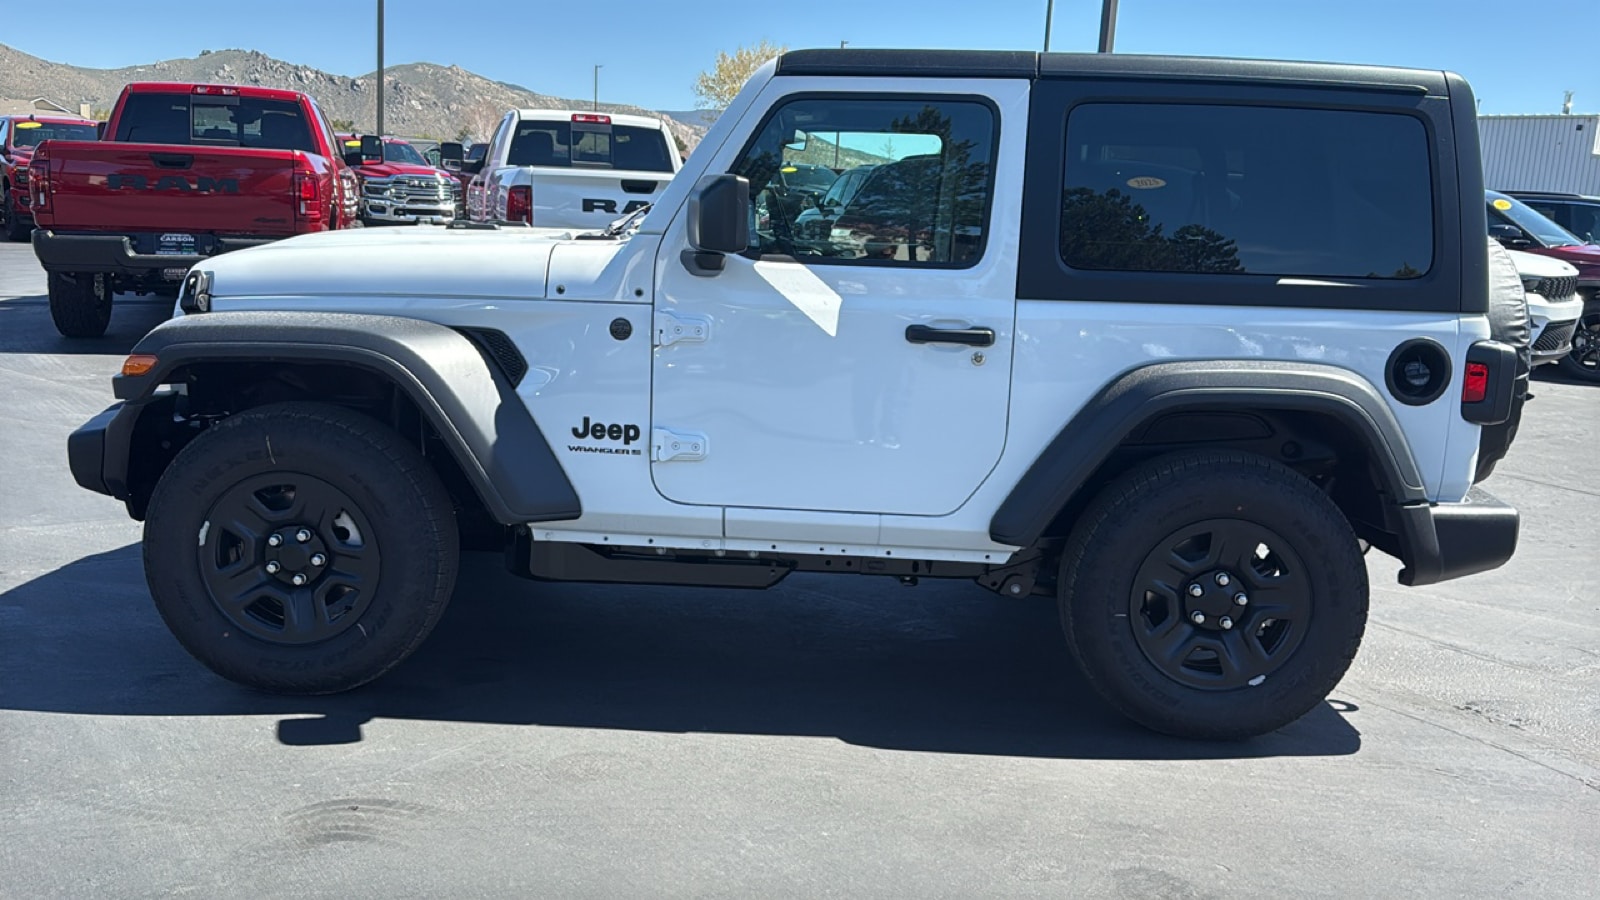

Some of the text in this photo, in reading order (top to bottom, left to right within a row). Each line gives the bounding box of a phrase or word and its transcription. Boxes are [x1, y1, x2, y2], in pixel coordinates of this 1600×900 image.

[107, 174, 239, 192] RAM
[582, 199, 652, 214] RA
[571, 416, 640, 445] Jeep
[568, 445, 630, 455] WRANGLER
